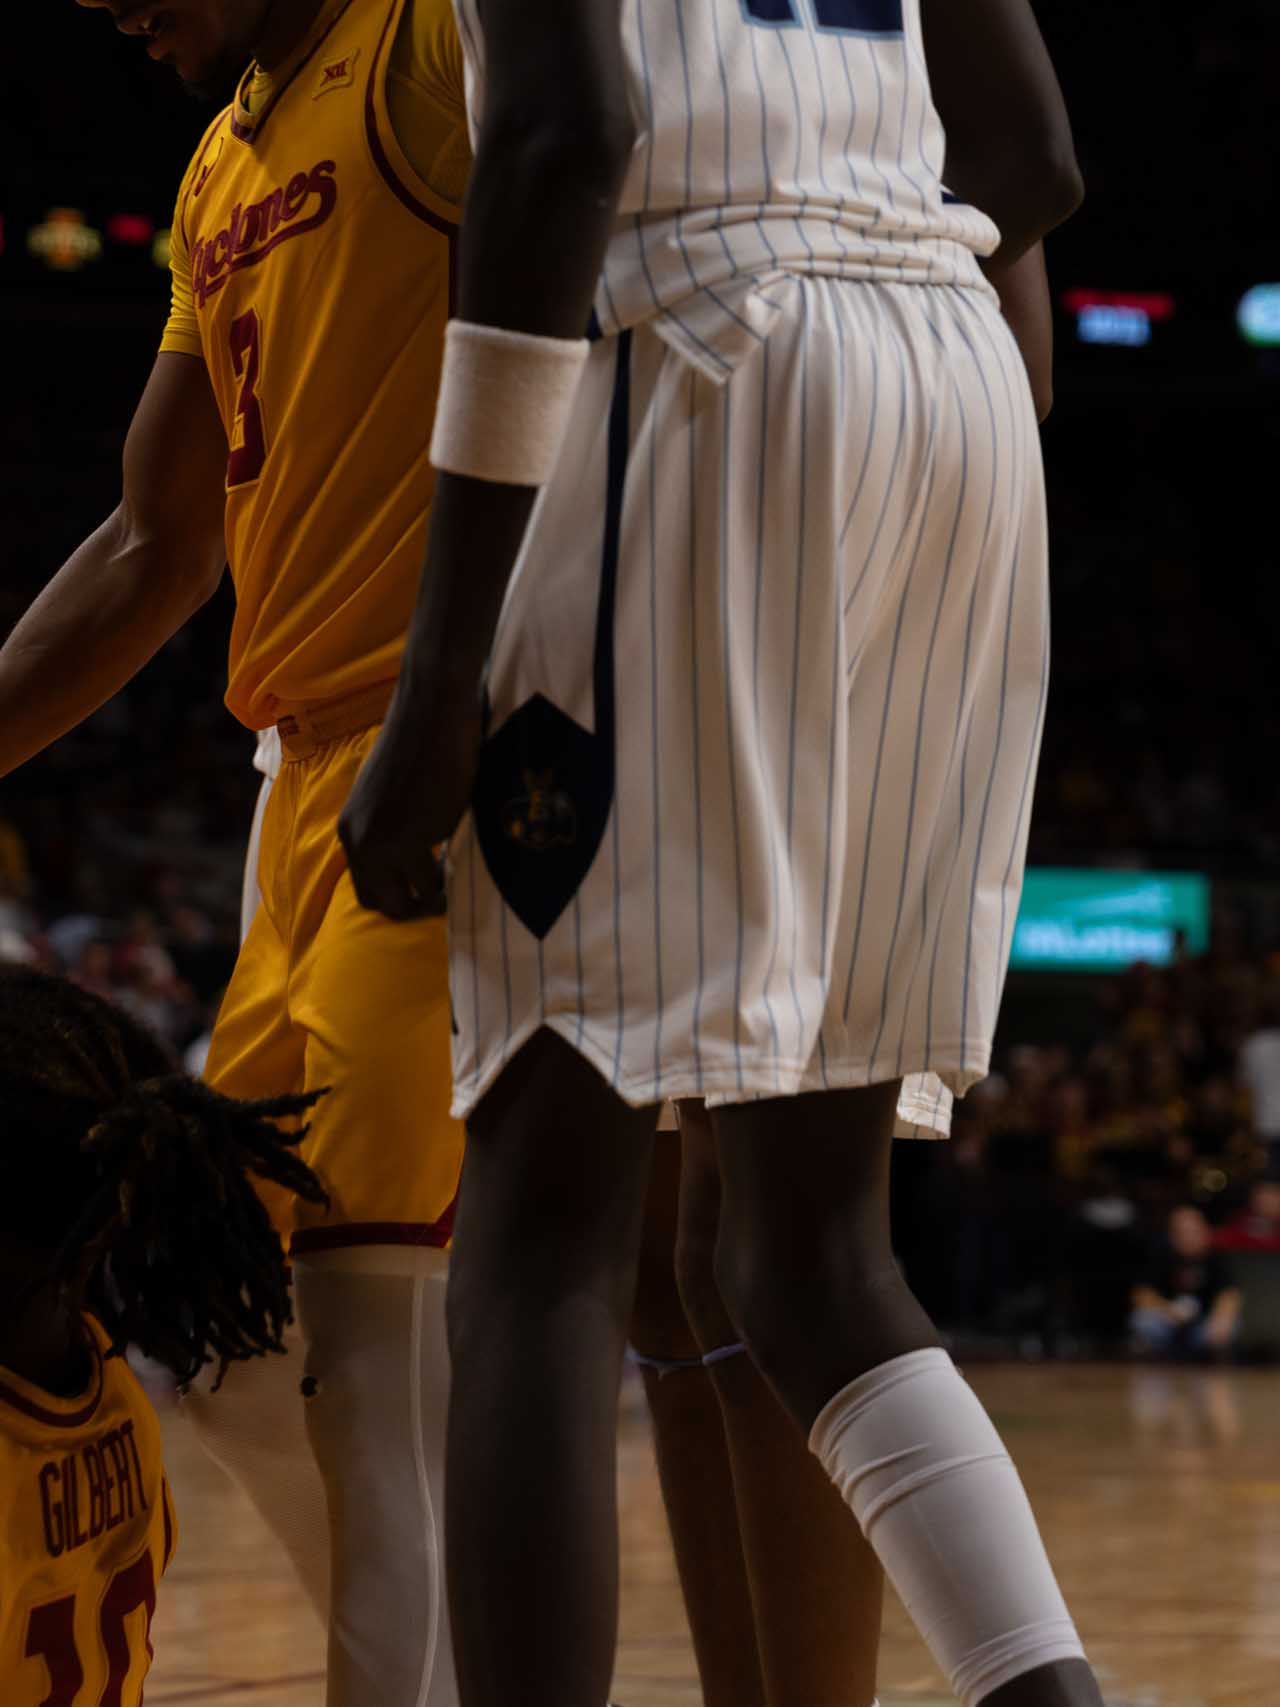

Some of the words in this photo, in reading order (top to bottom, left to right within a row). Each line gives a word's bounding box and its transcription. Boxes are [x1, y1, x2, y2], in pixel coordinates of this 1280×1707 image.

[227, 309, 267, 487] 3
[39, 1419, 148, 1557] GILBERT
[24, 1548, 157, 1707] 10
